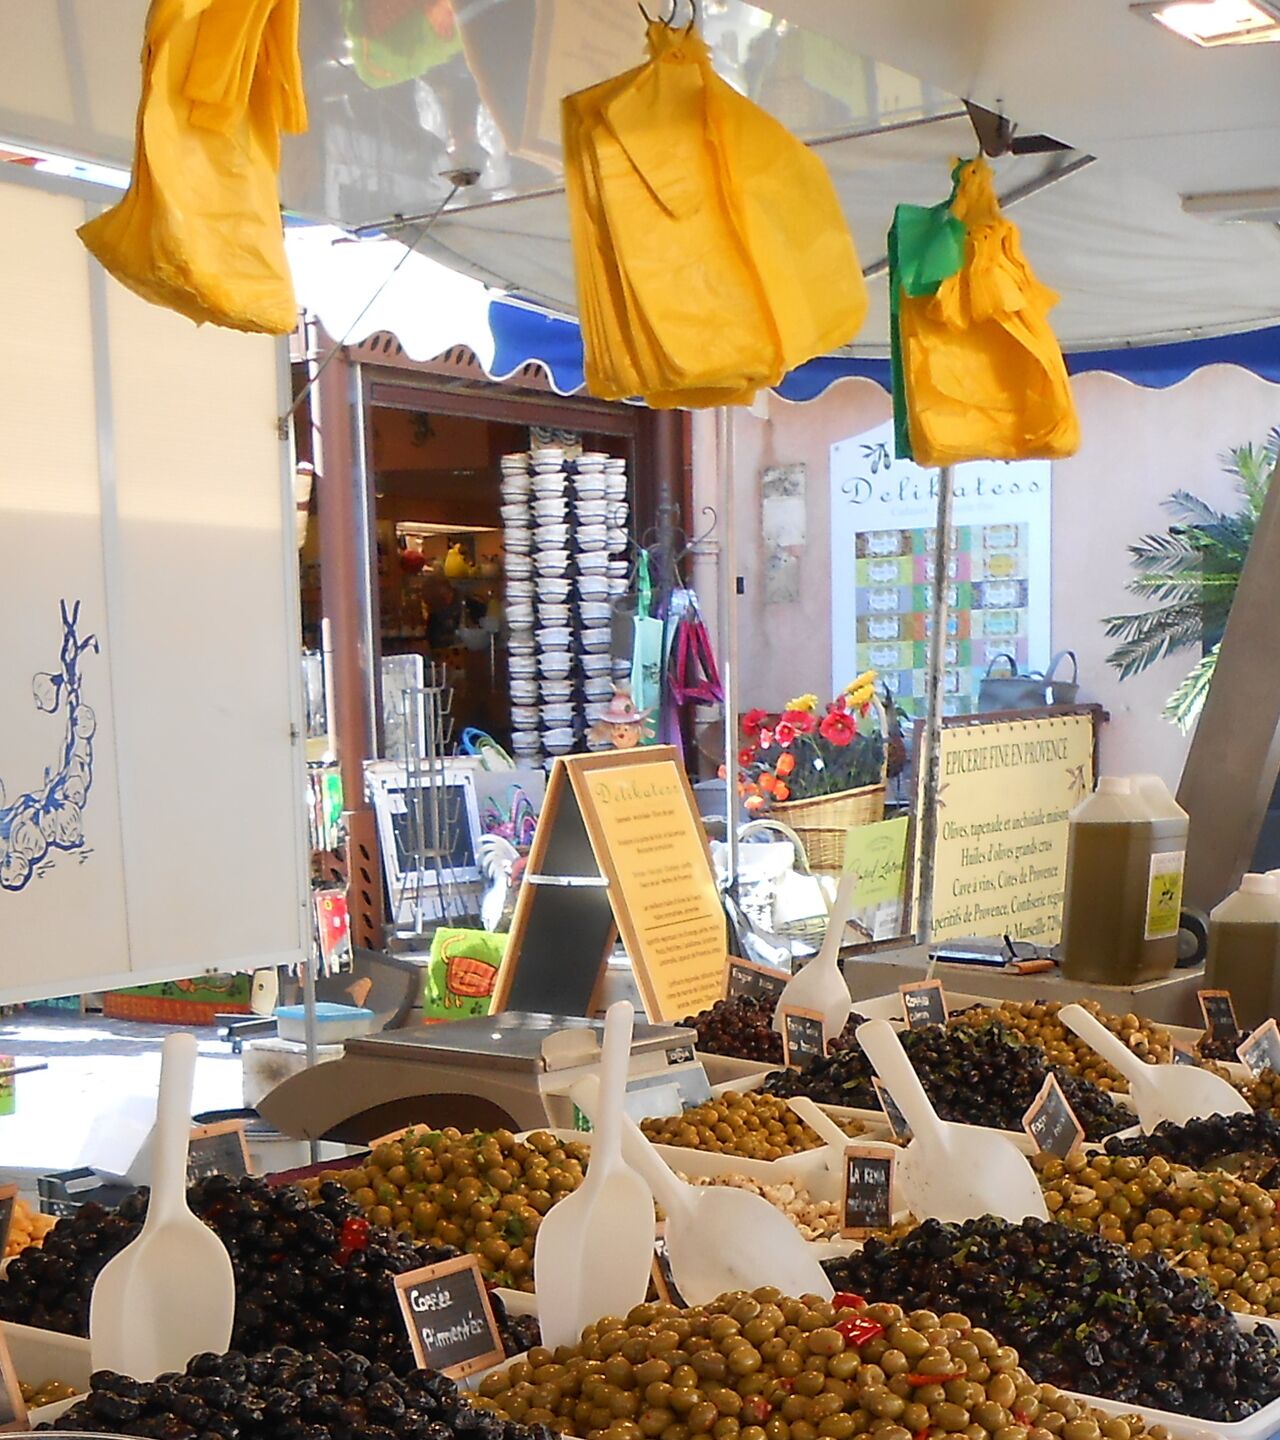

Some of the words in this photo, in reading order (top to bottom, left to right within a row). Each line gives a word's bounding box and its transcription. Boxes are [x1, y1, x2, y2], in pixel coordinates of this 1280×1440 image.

[946, 747, 988, 775] EPICERIE
[990, 744, 1009, 769] FINE
[1011, 743, 1023, 766] EN
[1024, 738, 1068, 764] PROVENCE
[1029, 865, 1058, 882] Provence
